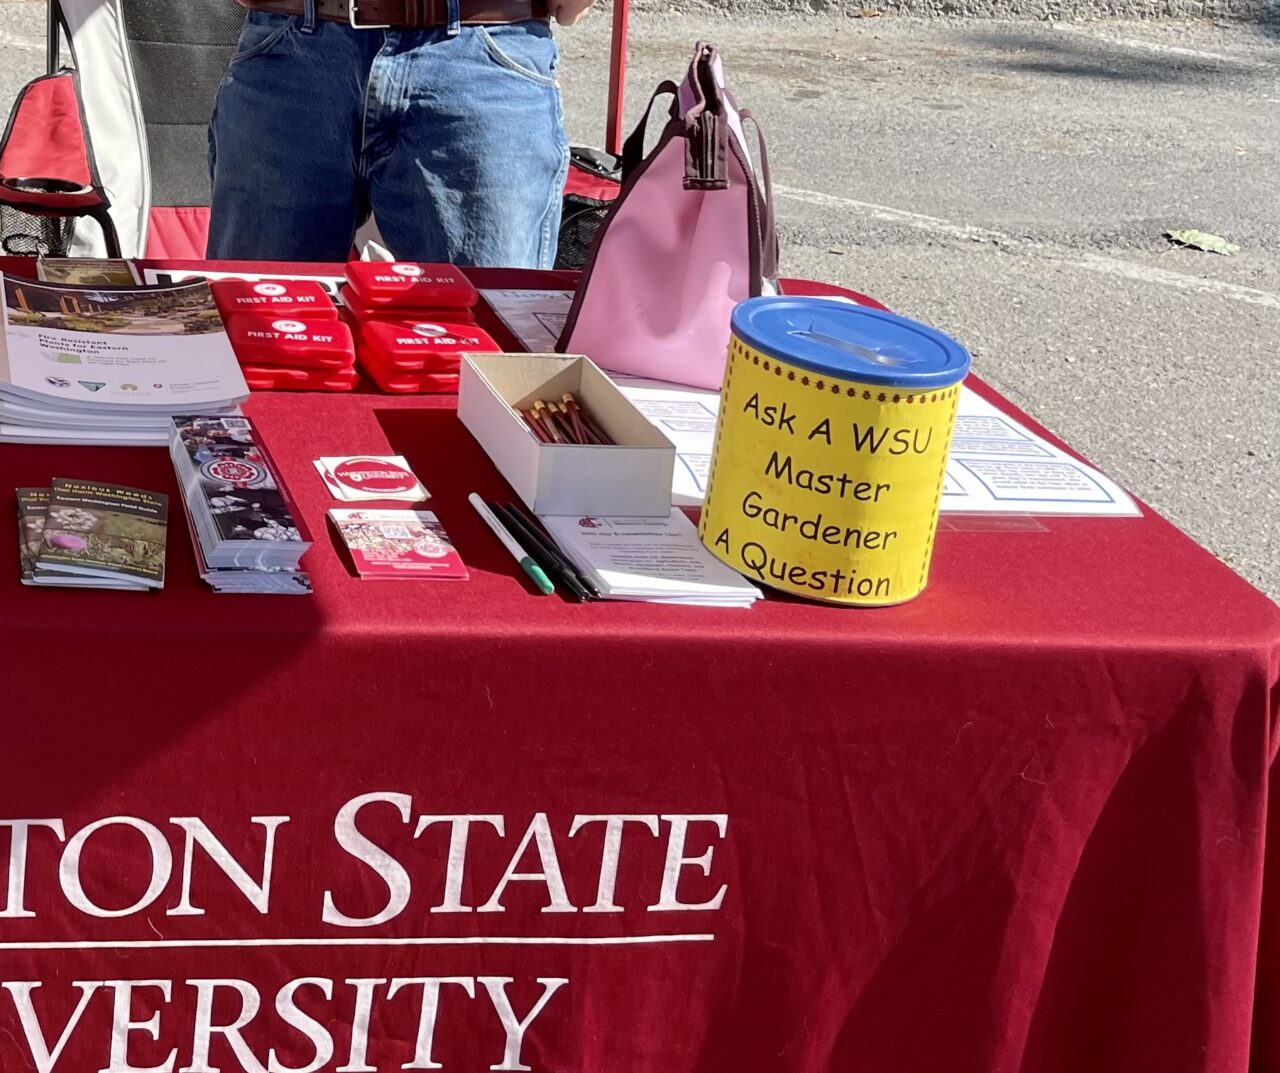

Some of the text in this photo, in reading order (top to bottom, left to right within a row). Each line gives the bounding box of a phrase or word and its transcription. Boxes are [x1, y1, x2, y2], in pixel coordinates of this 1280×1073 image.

[374, 275, 455, 284] FIRST AID KIT
[236, 295, 316, 304] FIRST AID KIT
[247, 331, 280, 340] FIRST
[312, 335, 333, 343] KIT
[434, 337, 456, 345] AID
[742, 391, 933, 457] Ask A WSU
[764, 450, 891, 504] Master
[65, 483, 153, 500] Noxious Weeds
[82, 498, 120, 507] Washington
[741, 491, 898, 552] Gardener
[714, 528, 731, 554] A
[740, 540, 891, 597] Question
[321, 790, 730, 928] STATE
